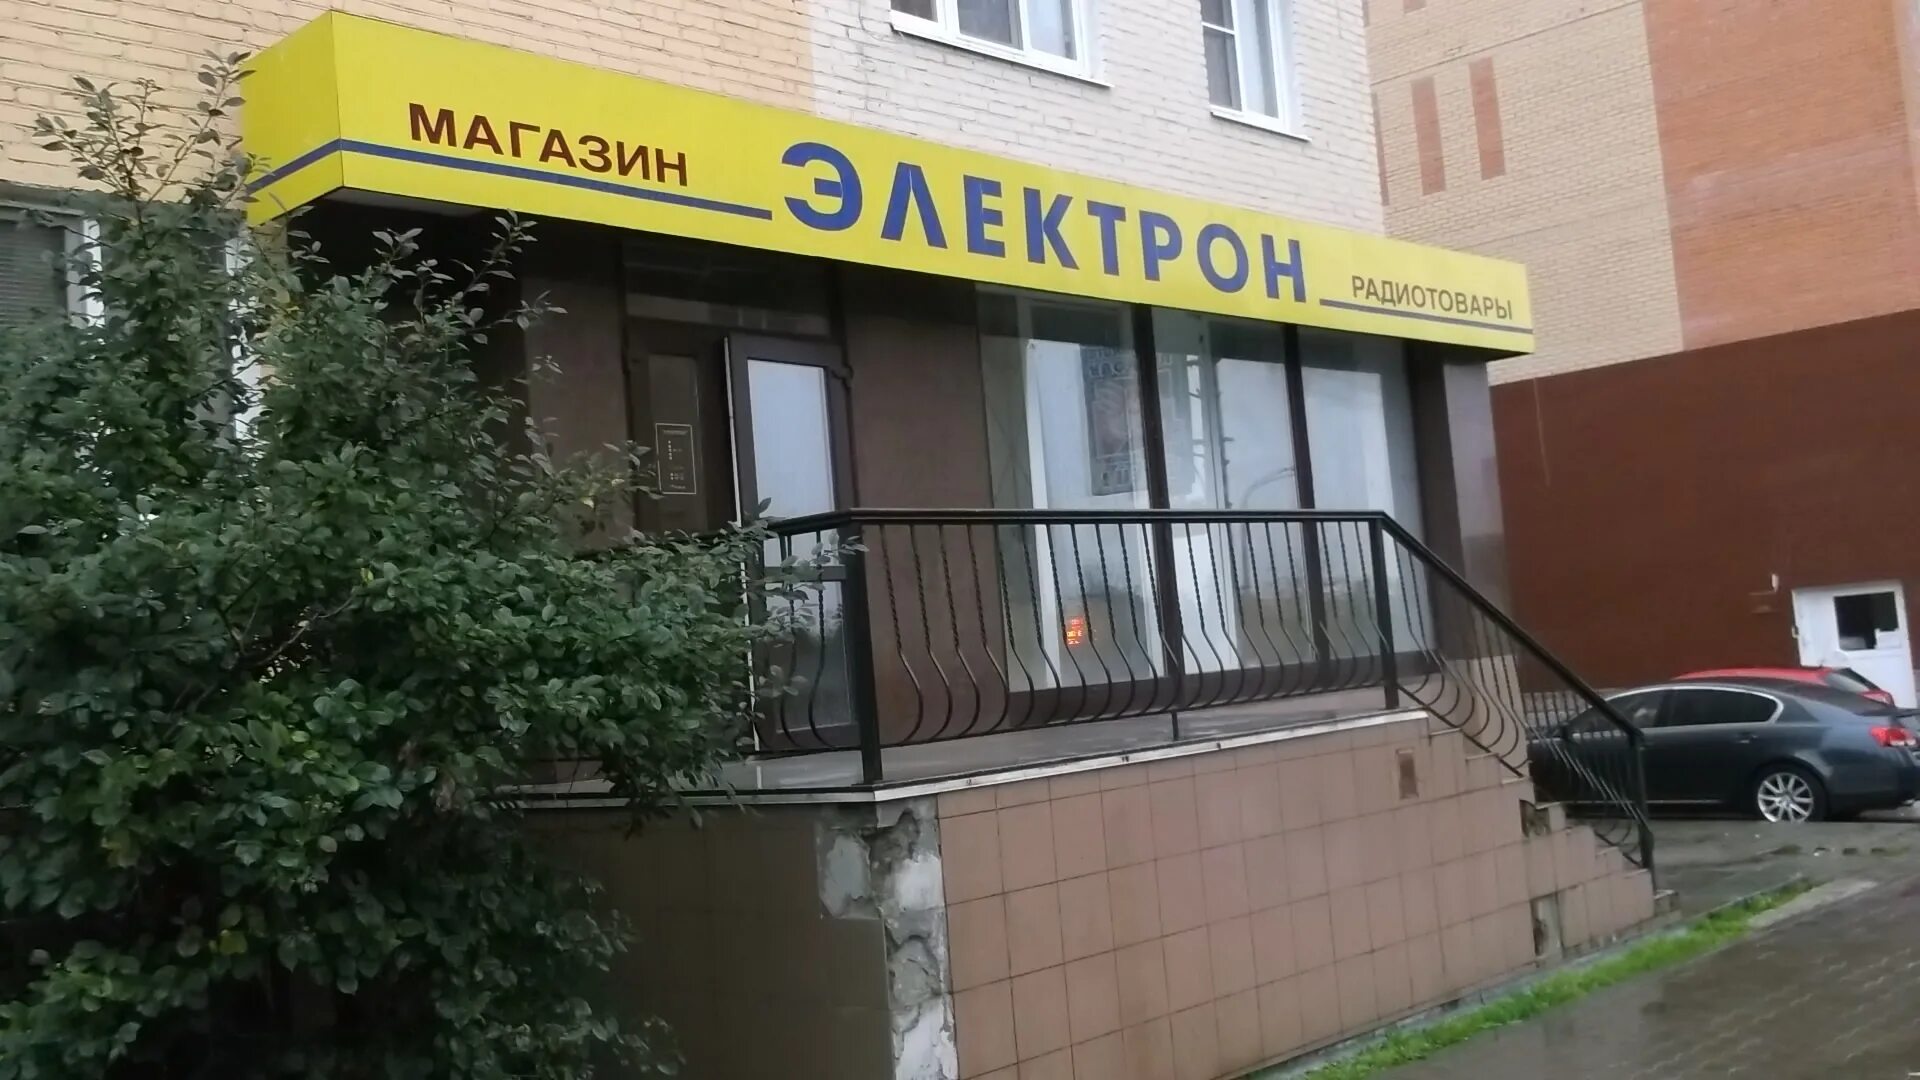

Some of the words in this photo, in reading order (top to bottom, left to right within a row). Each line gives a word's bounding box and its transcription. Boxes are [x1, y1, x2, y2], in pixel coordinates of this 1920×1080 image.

[409, 103, 688, 186] МАГАЗИН
[781, 142, 1307, 303] ЭЛЕКТРОН
[1351, 275, 1513, 320] РАДИОТОВАРЫ
